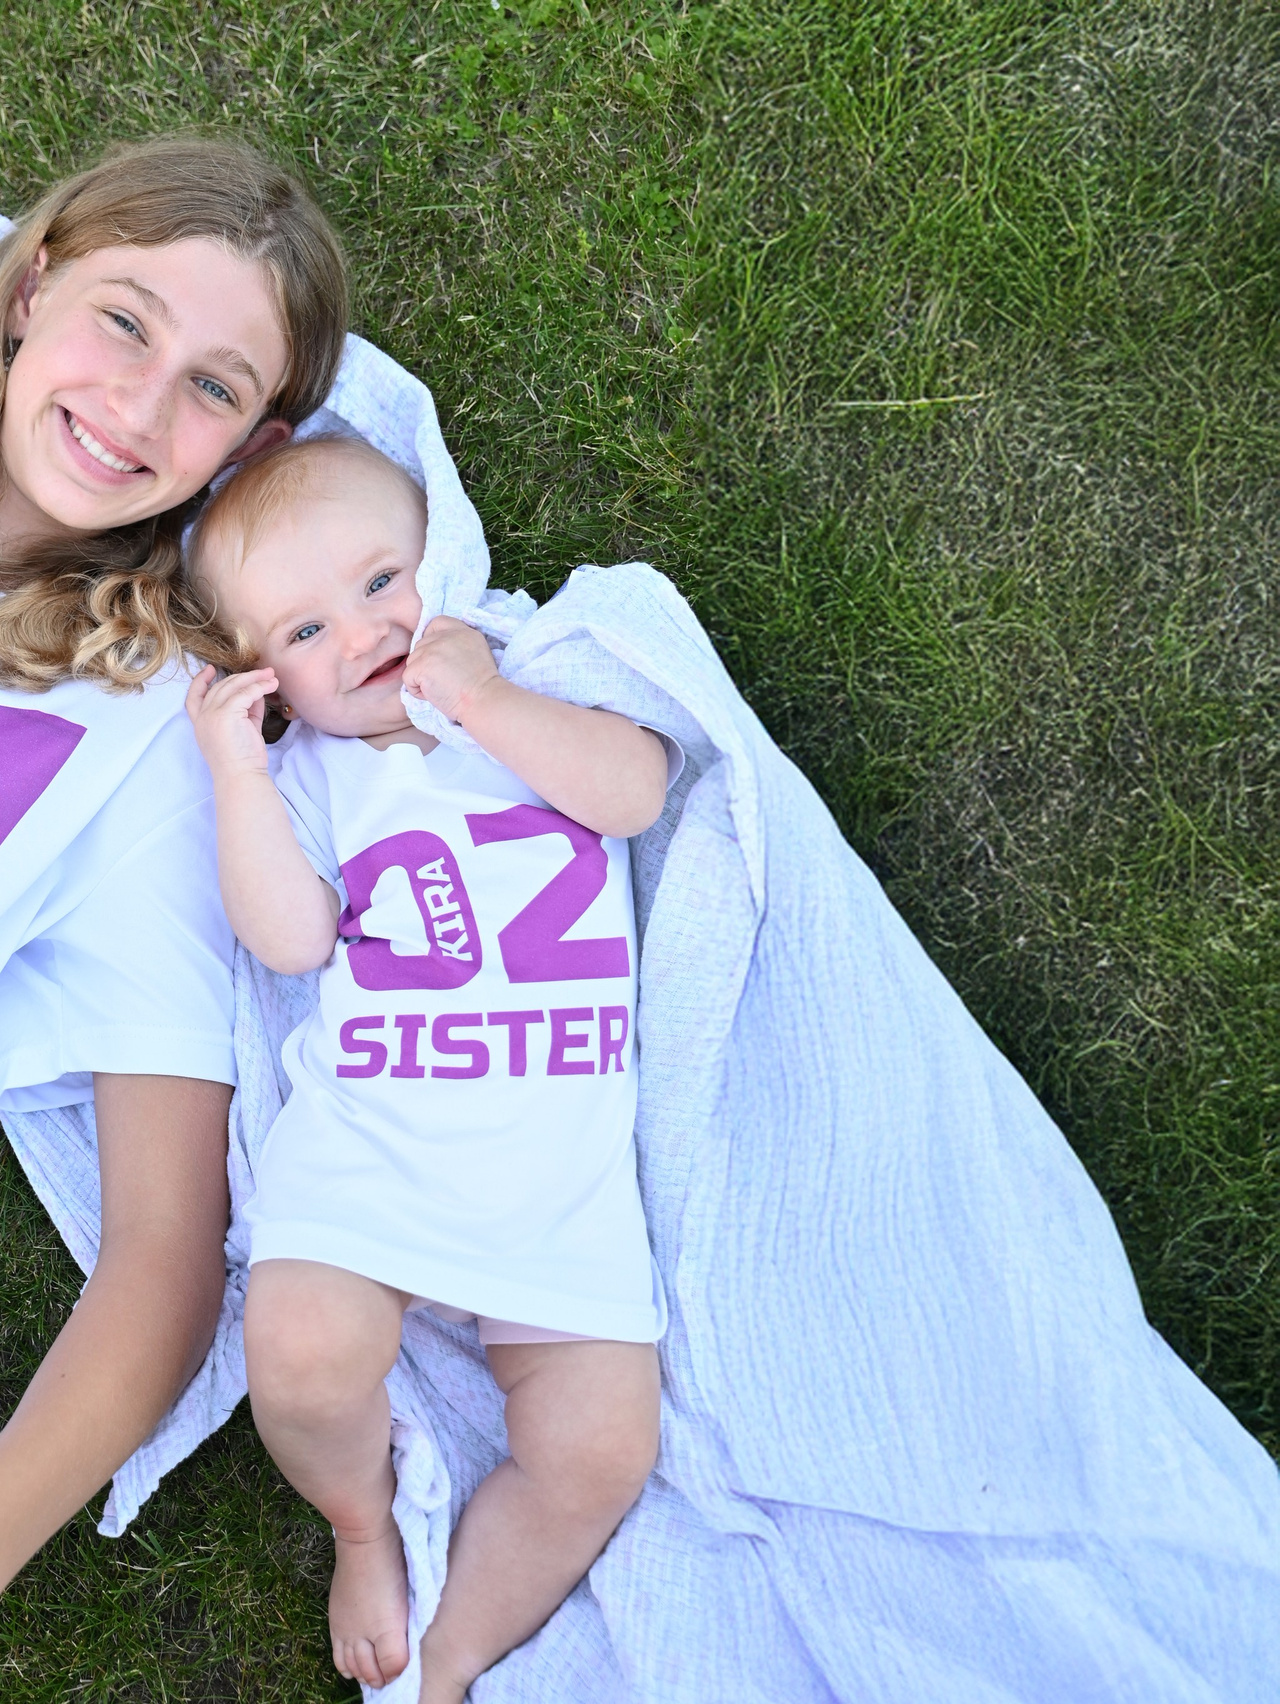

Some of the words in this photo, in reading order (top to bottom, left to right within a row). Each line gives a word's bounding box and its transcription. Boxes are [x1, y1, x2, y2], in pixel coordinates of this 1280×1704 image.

[337, 803, 631, 992] 02
[415, 856, 474, 962] KIRA
[336, 1005, 629, 1080] SISTER
